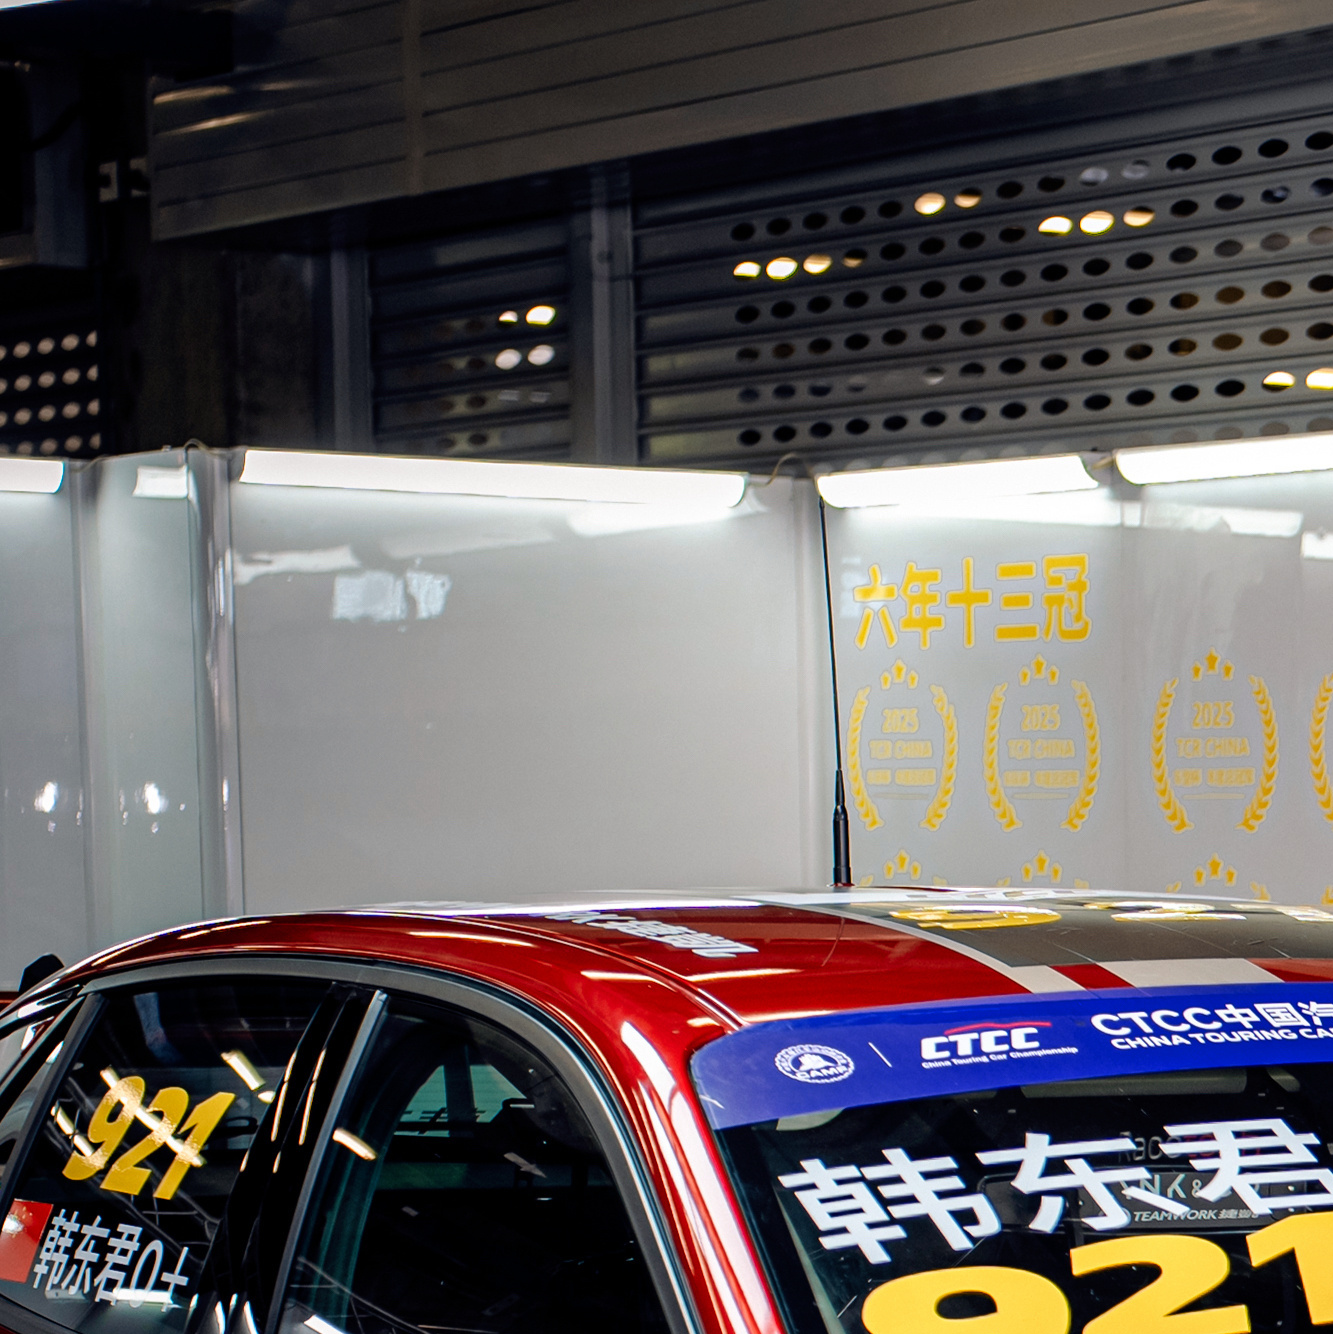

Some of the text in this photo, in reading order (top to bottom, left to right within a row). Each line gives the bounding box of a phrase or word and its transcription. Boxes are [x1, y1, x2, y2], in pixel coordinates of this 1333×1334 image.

[853, 552, 1092, 649] 六年十三冠
[1021, 704, 1060, 732] 2025
[1191, 701, 1234, 729] 2025
[1175, 736, 1250, 758] TCR CHINA
[921, 1027, 1040, 1060] CTCC
[1110, 1034, 1191, 1049] CHINA
[1189, 1028, 1299, 1045] TOURING
[921, 1058, 951, 1069] China
[951, 1055, 989, 1066] Touring
[1009, 1046, 1079, 1060] Championship
[62, 1075, 236, 1201] 921
[33, 1208, 144, 1307] 韩东君
